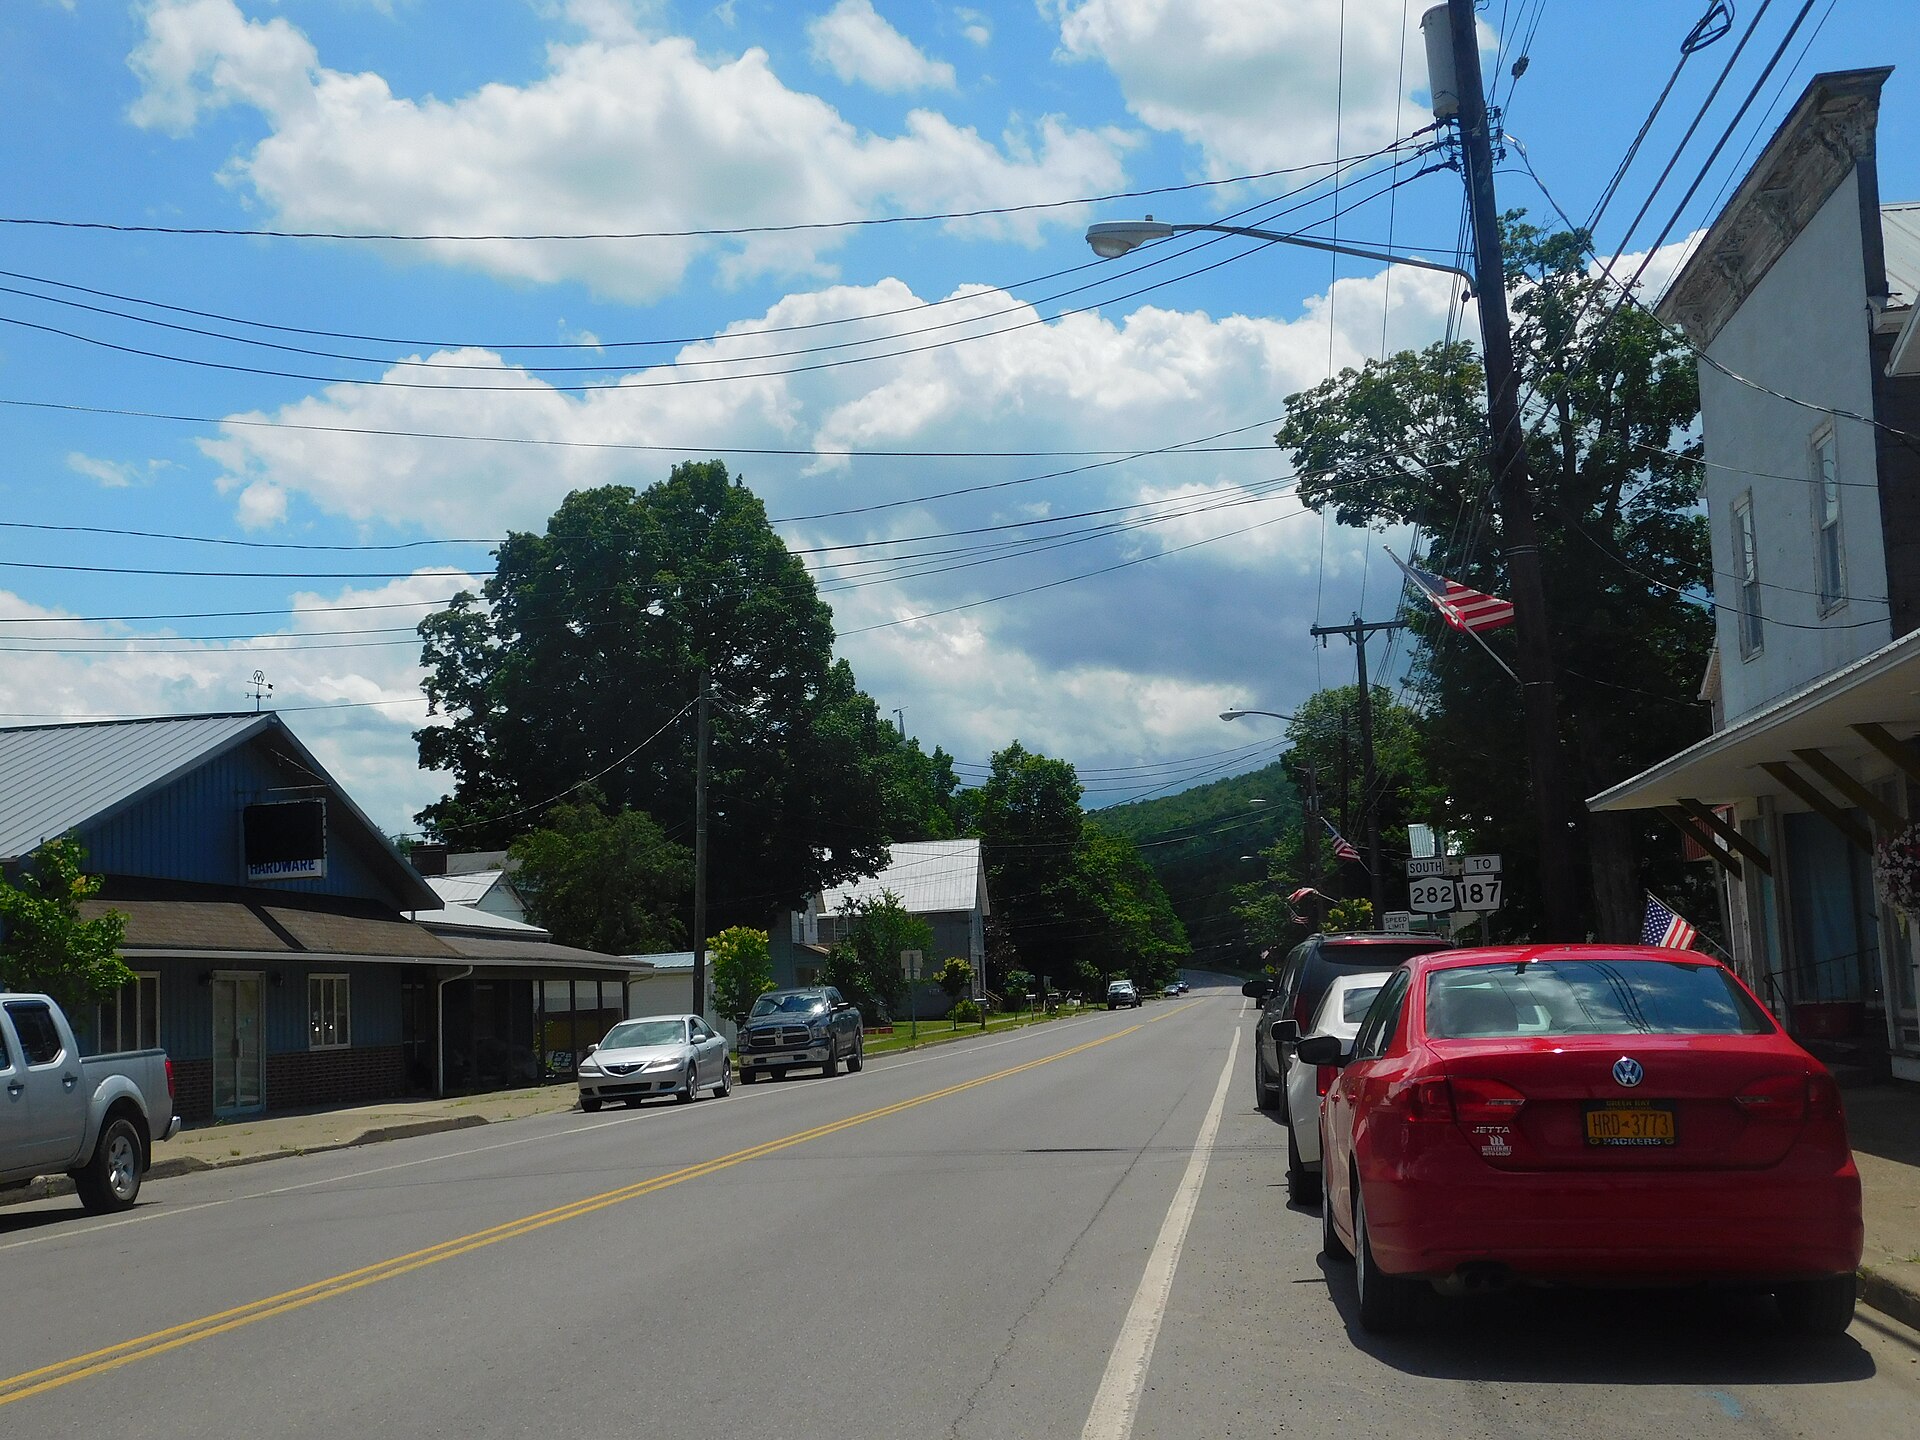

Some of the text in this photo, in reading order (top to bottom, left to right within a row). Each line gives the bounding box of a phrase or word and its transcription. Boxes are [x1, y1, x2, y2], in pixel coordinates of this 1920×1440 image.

[250, 859, 315, 875] HARDWARE
[1409, 861, 1442, 873] SOUTH
[1473, 858, 1491, 869] TO
[1412, 886, 1452, 904] 282
[1460, 882, 1499, 904] 187
[1385, 916, 1408, 924] SPEED
[1472, 1126, 1511, 1134] JETTA
[1602, 1137, 1661, 1146] PACKERS
